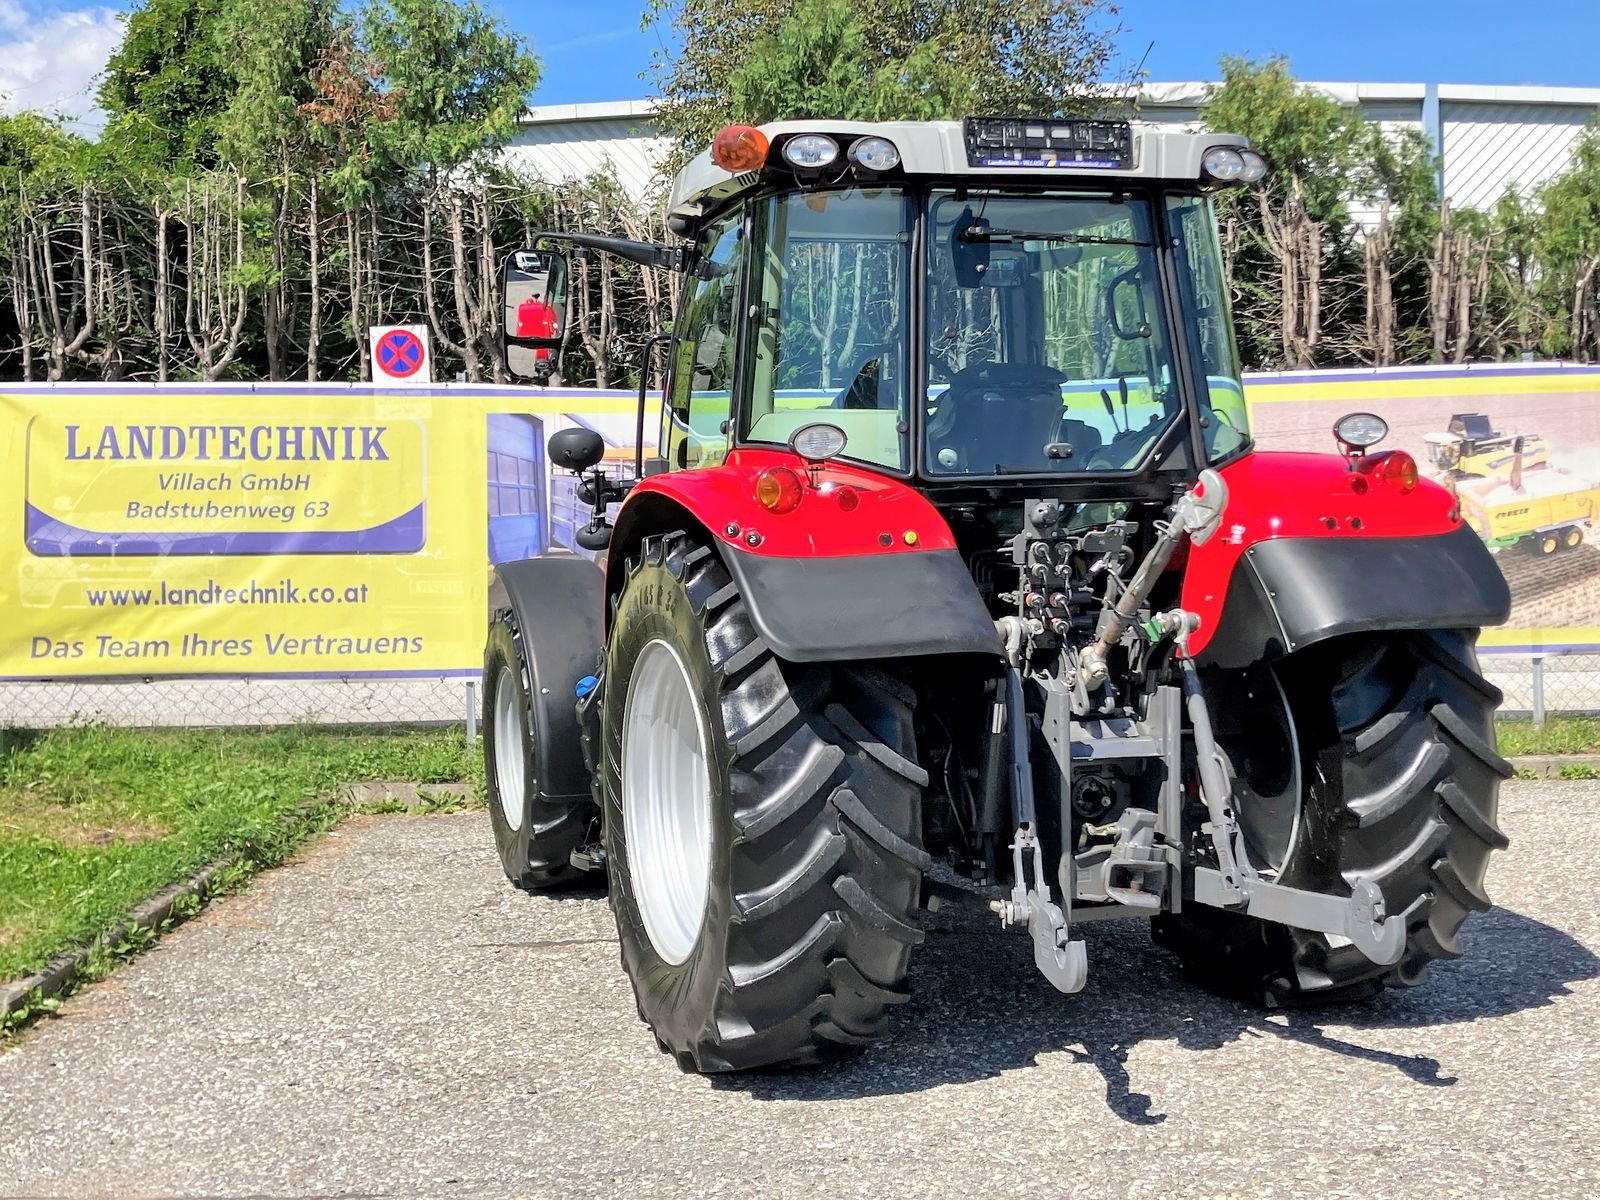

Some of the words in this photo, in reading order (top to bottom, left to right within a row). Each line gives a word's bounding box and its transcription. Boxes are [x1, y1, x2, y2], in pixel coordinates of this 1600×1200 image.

[65, 425, 390, 461] LANDTECHNIK
[158, 472, 232, 491] Villach
[240, 473, 311, 491] GmbH
[126, 500, 296, 523] Badstubenweg
[303, 501, 330, 518] 63
[87, 578, 369, 607] www.landtechnik.co.at
[31, 636, 84, 659] Das
[96, 635, 170, 658] Team
[182, 632, 253, 656] Ihres
[265, 632, 424, 655] Vertrauens
